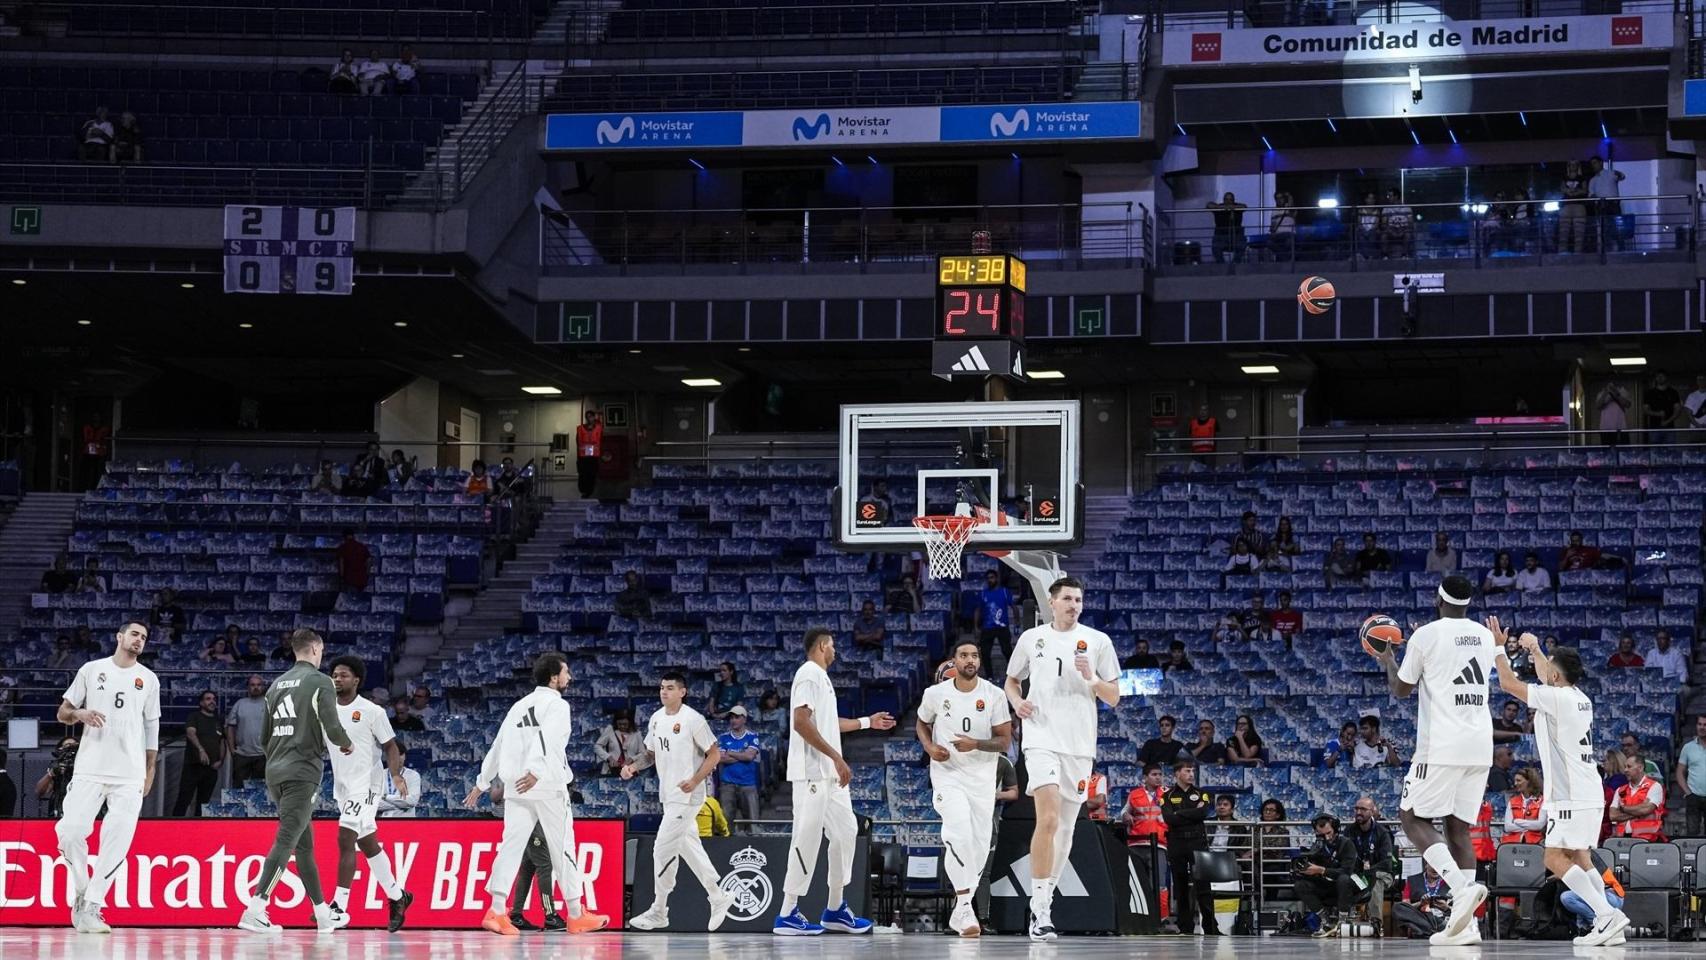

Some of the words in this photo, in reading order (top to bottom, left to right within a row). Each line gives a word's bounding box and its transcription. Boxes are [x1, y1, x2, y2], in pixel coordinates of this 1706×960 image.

[1263, 30, 1418, 54] Comunidad
[1428, 28, 1461, 47] de
[1472, 24, 1568, 46] Madrid
[837, 116, 891, 126] Movistar
[1036, 112, 1090, 122] Movistar
[641, 120, 694, 130] Movistar
[1036, 124, 1088, 132] ARENA
[641, 132, 692, 140] ARENA
[838, 128, 889, 136] ARENA
[941, 258, 1005, 282] 24:38
[945, 291, 999, 334] 24
[1455, 636, 1482, 646] GARUBA
[114, 691, 125, 709] 6
[962, 717, 971, 733] 0
[659, 736, 670, 752] 14
